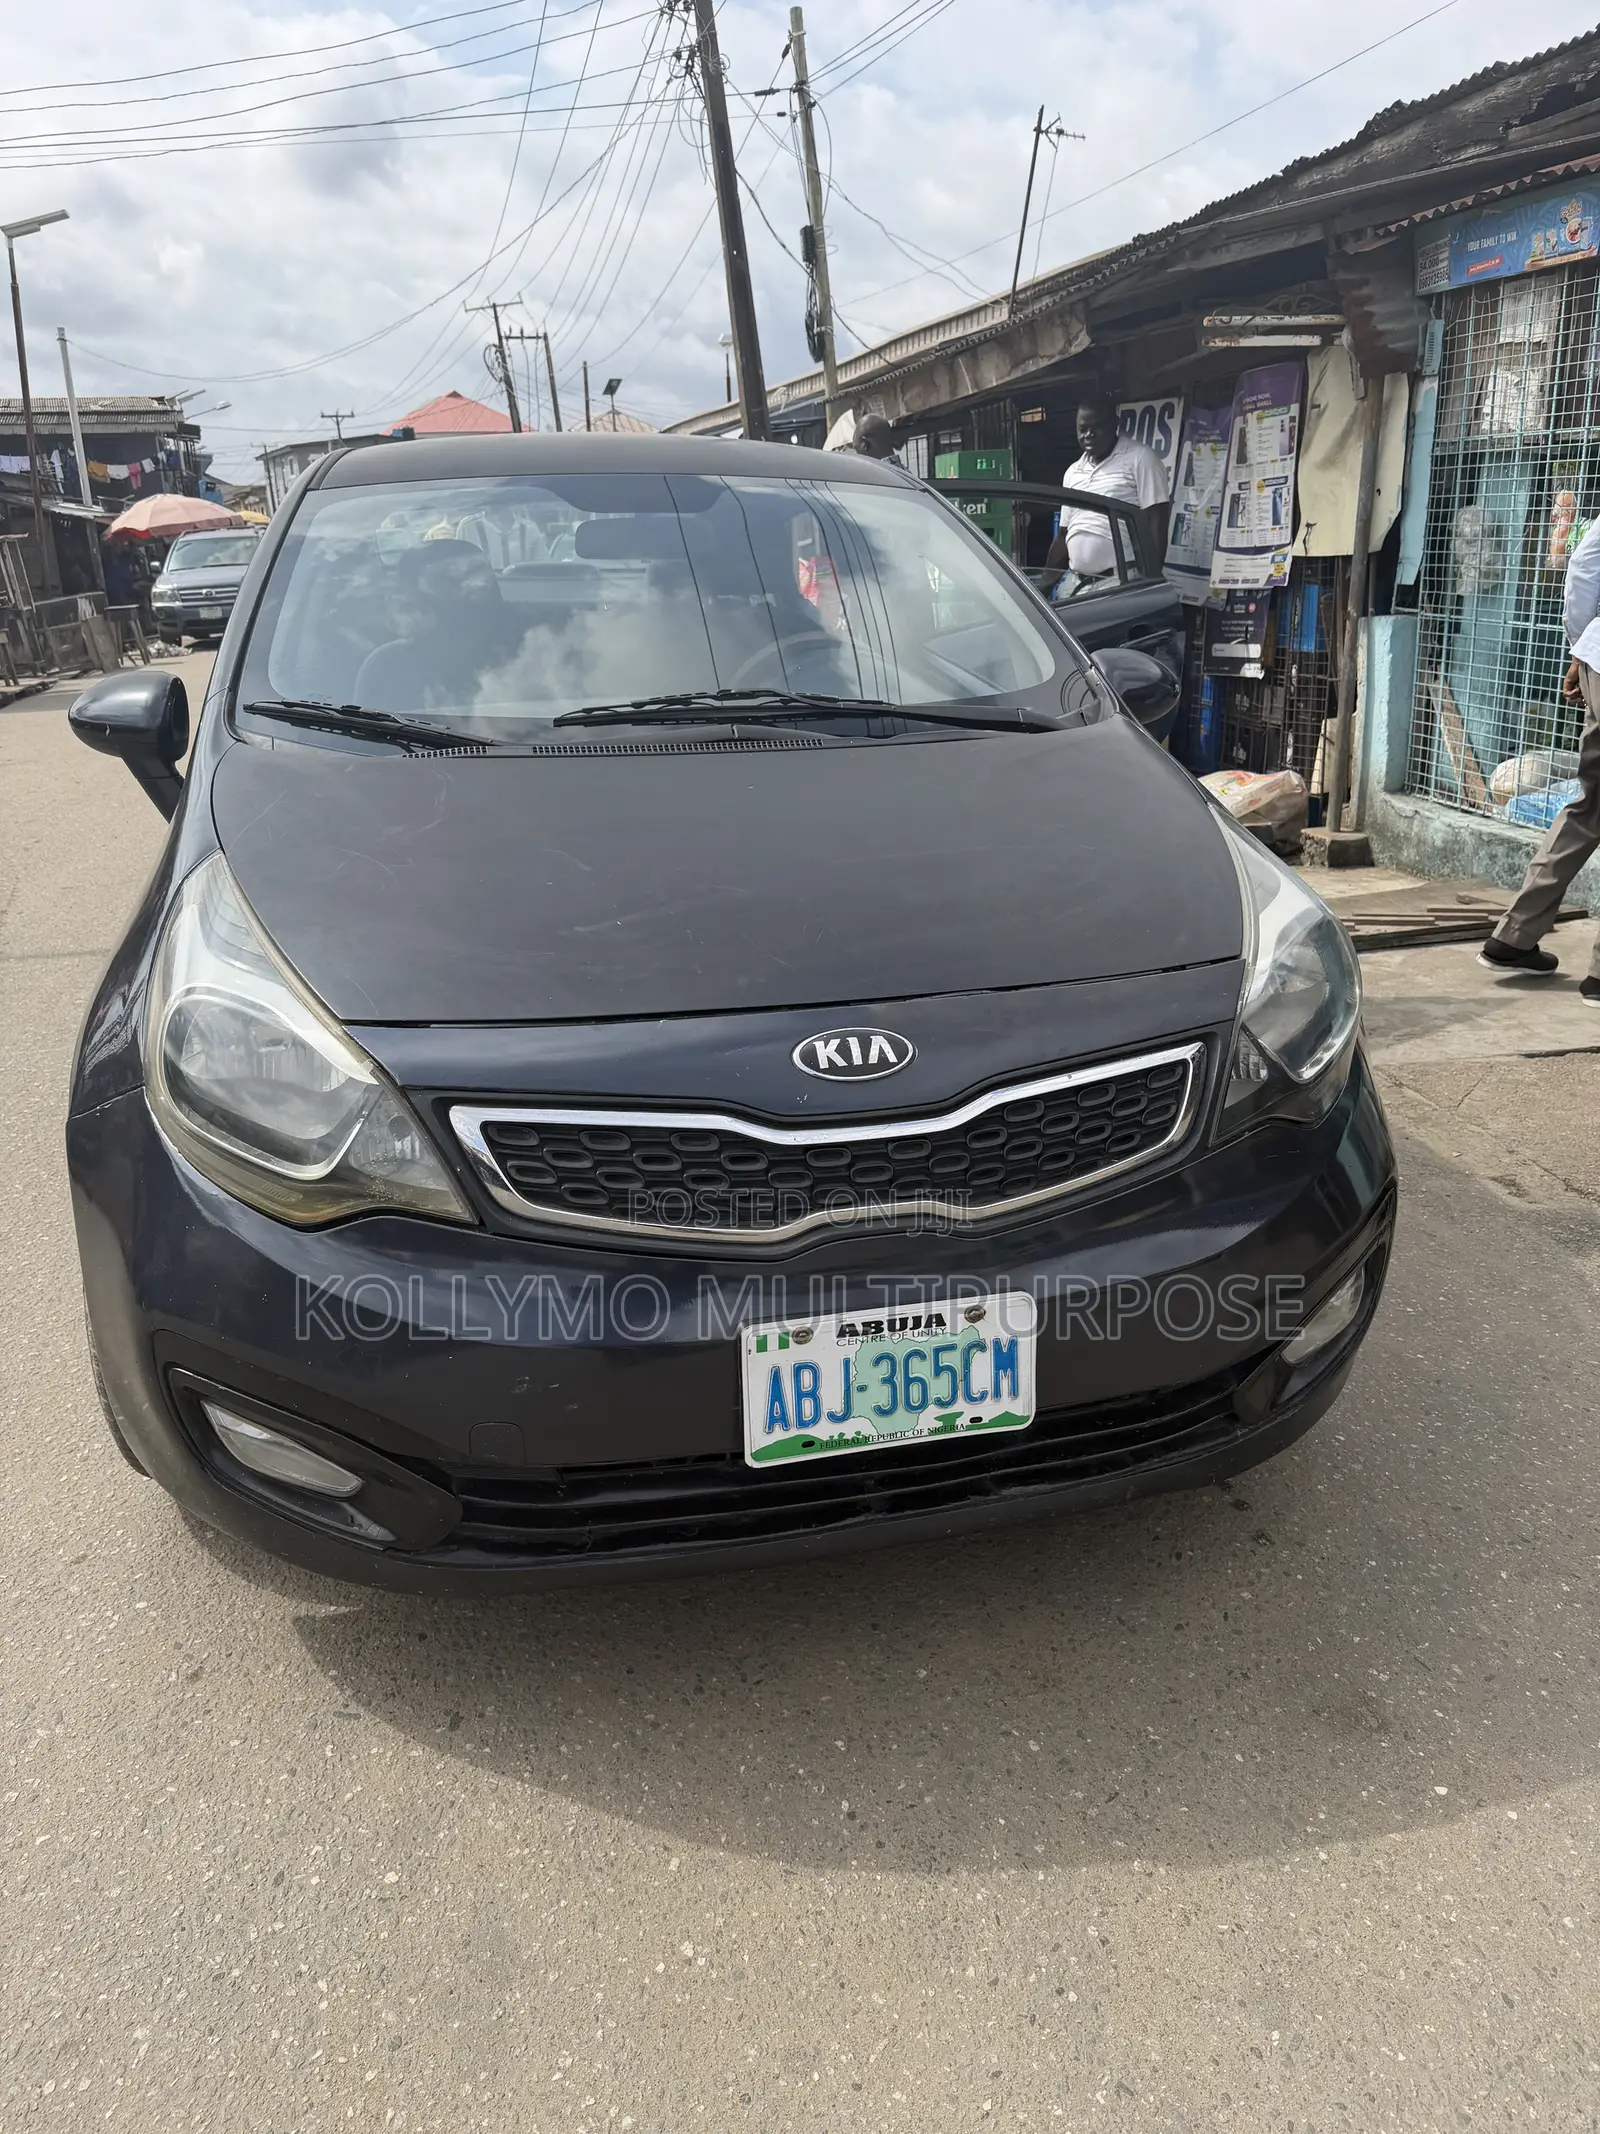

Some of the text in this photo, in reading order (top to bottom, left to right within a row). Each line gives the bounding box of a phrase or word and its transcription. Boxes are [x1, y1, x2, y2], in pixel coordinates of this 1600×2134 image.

[1480, 235, 1499, 249] FAMILY
[1120, 401, 1175, 461] POS
[813, 1035, 898, 1069] KIA
[836, 1313, 947, 1339] ABUJA
[836, 1327, 947, 1347] CENTRE OF UNITY
[819, 1423, 966, 1450] FEDERAL REPUBLIC OF NIGERIA
